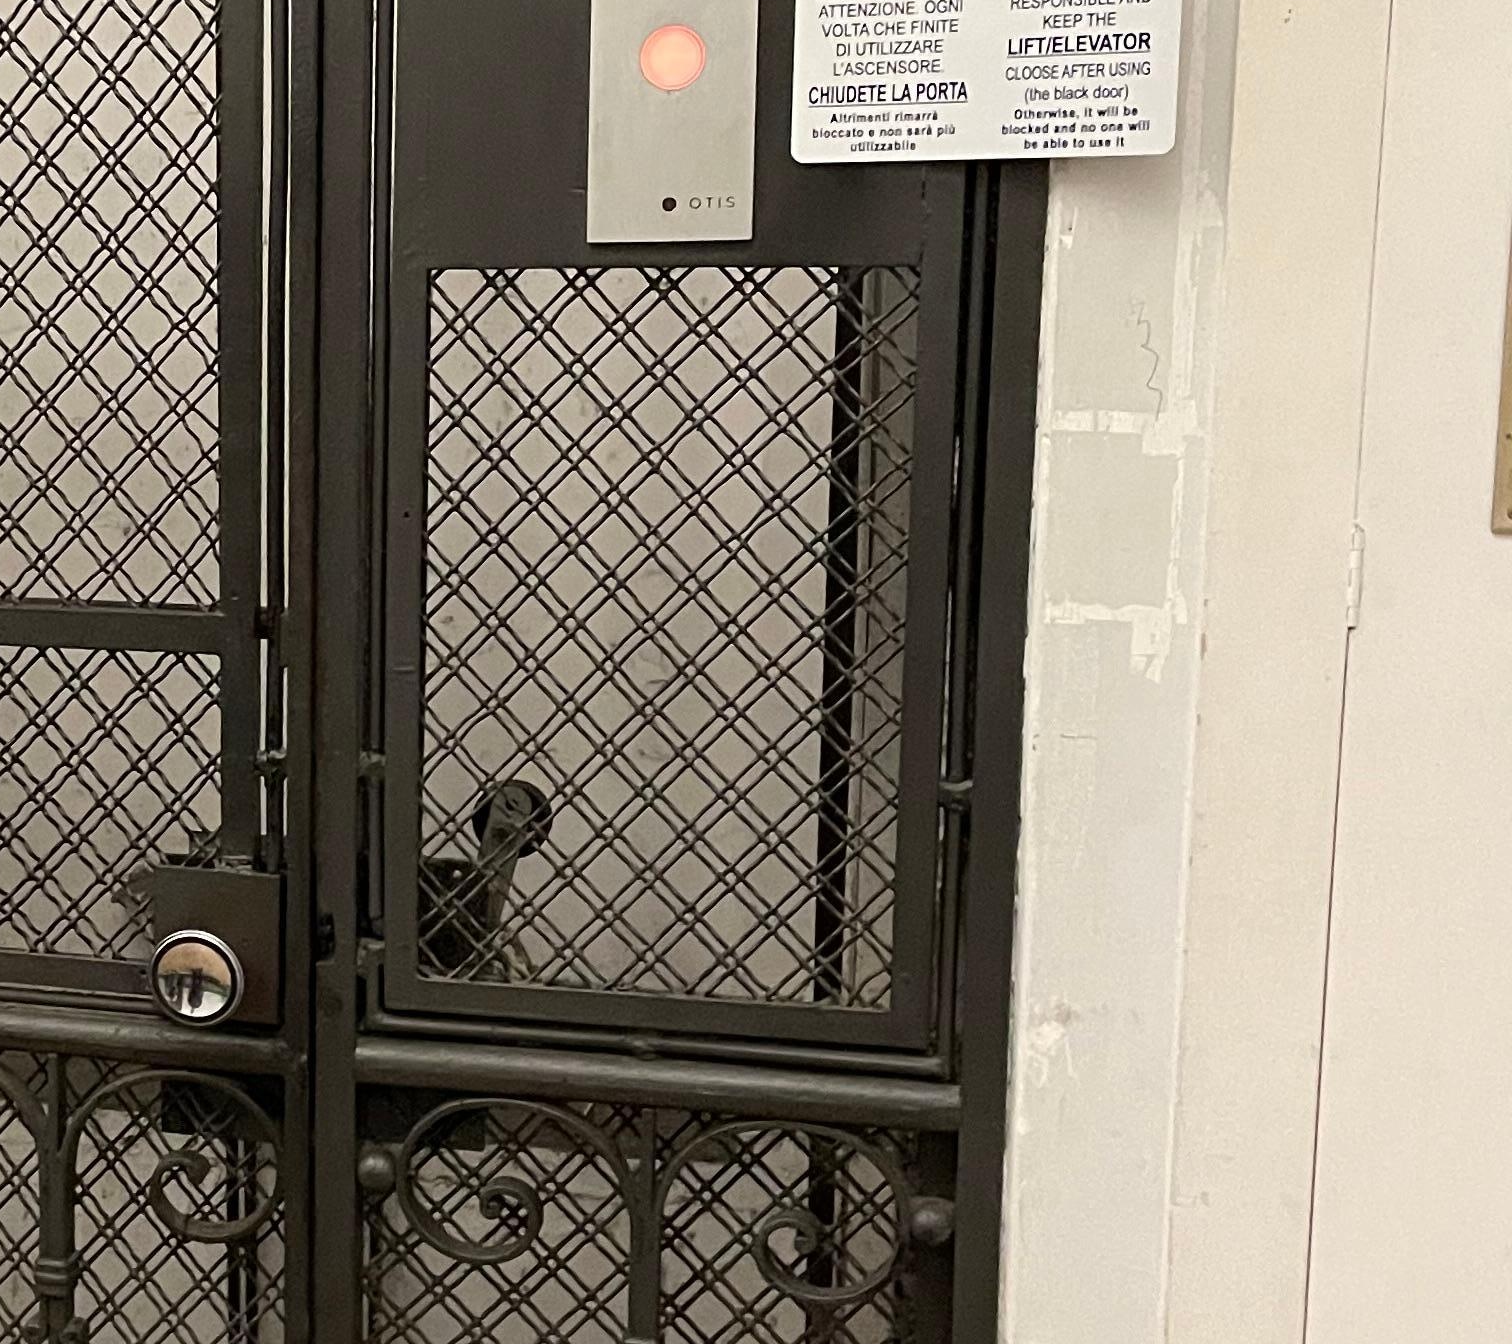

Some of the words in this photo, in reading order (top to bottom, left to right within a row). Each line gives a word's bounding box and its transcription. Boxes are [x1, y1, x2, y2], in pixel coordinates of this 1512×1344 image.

[924, 0, 964, 13] OGNI
[821, 23, 870, 38] VOLTA
[873, 21, 906, 36] CHE
[910, 18, 959, 34] FINITE
[1043, 13, 1083, 29] KEEP
[1088, 12, 1117, 26] THE
[836, 43, 851, 57] DI
[856, 39, 944, 56] UTILIZZARE
[1007, 32, 1151, 57] LIFT/ELEVATOR
[1005, 64, 1059, 81] CLOOSE
[1061, 63, 1105, 79] AFTER
[1108, 61, 1151, 77] USING
[808, 85, 887, 107] CHIUDETE
[891, 83, 912, 102] LA
[915, 81, 968, 102] PORTA
[1024, 87, 1050, 104] (the
[1054, 85, 1088, 100] black
[1093, 84, 1129, 102] door)
[830, 112, 890, 124] Altrimenti
[1014, 108, 1080, 120] Otherwise,
[1084, 107, 1093, 118] it
[1097, 106, 1119, 117] will
[1123, 106, 1138, 117] be
[812, 128, 864, 138] bloccato
[868, 129, 875, 137] e
[879, 128, 902, 137] non
[1001, 123, 1049, 135] blocked
[1054, 123, 1076, 133] and
[1080, 124, 1096, 133] no
[1100, 123, 1123, 132] one
[1128, 120, 1150, 131] will
[850, 140, 916, 152] utilizzabile
[1024, 139, 1038, 149] be
[1043, 138, 1068, 149] able
[1073, 138, 1085, 149] to
[1089, 138, 1111, 148] use
[1116, 136, 1125, 148] it
[689, 196, 736, 210] OTIS
